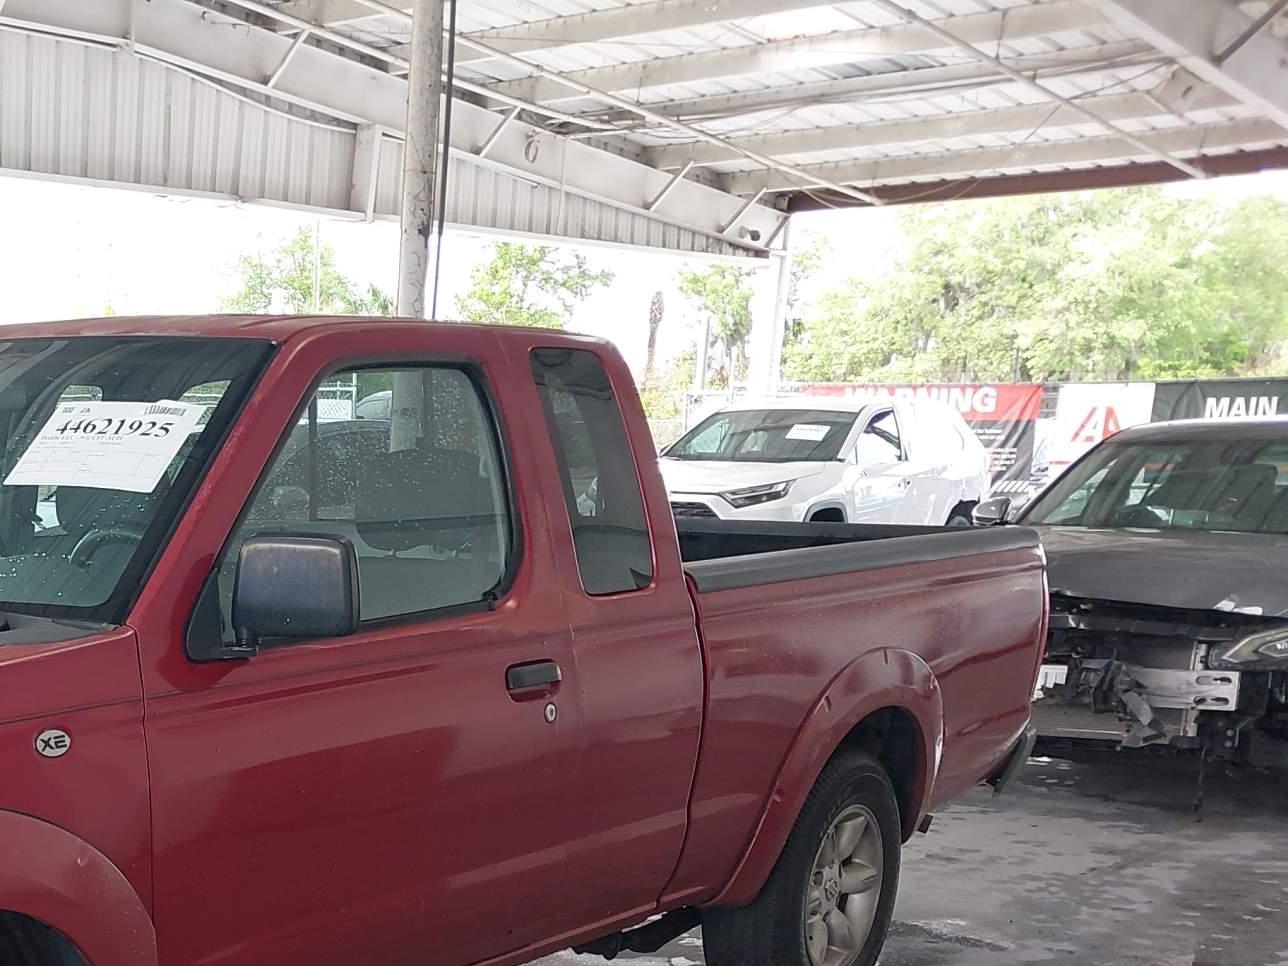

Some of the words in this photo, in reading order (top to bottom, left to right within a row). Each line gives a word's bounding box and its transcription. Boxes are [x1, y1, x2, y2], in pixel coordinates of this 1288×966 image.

[1204, 396, 1279, 418] MAIN
[55, 418, 175, 438] 44621925
[39, 734, 68, 752] XE
